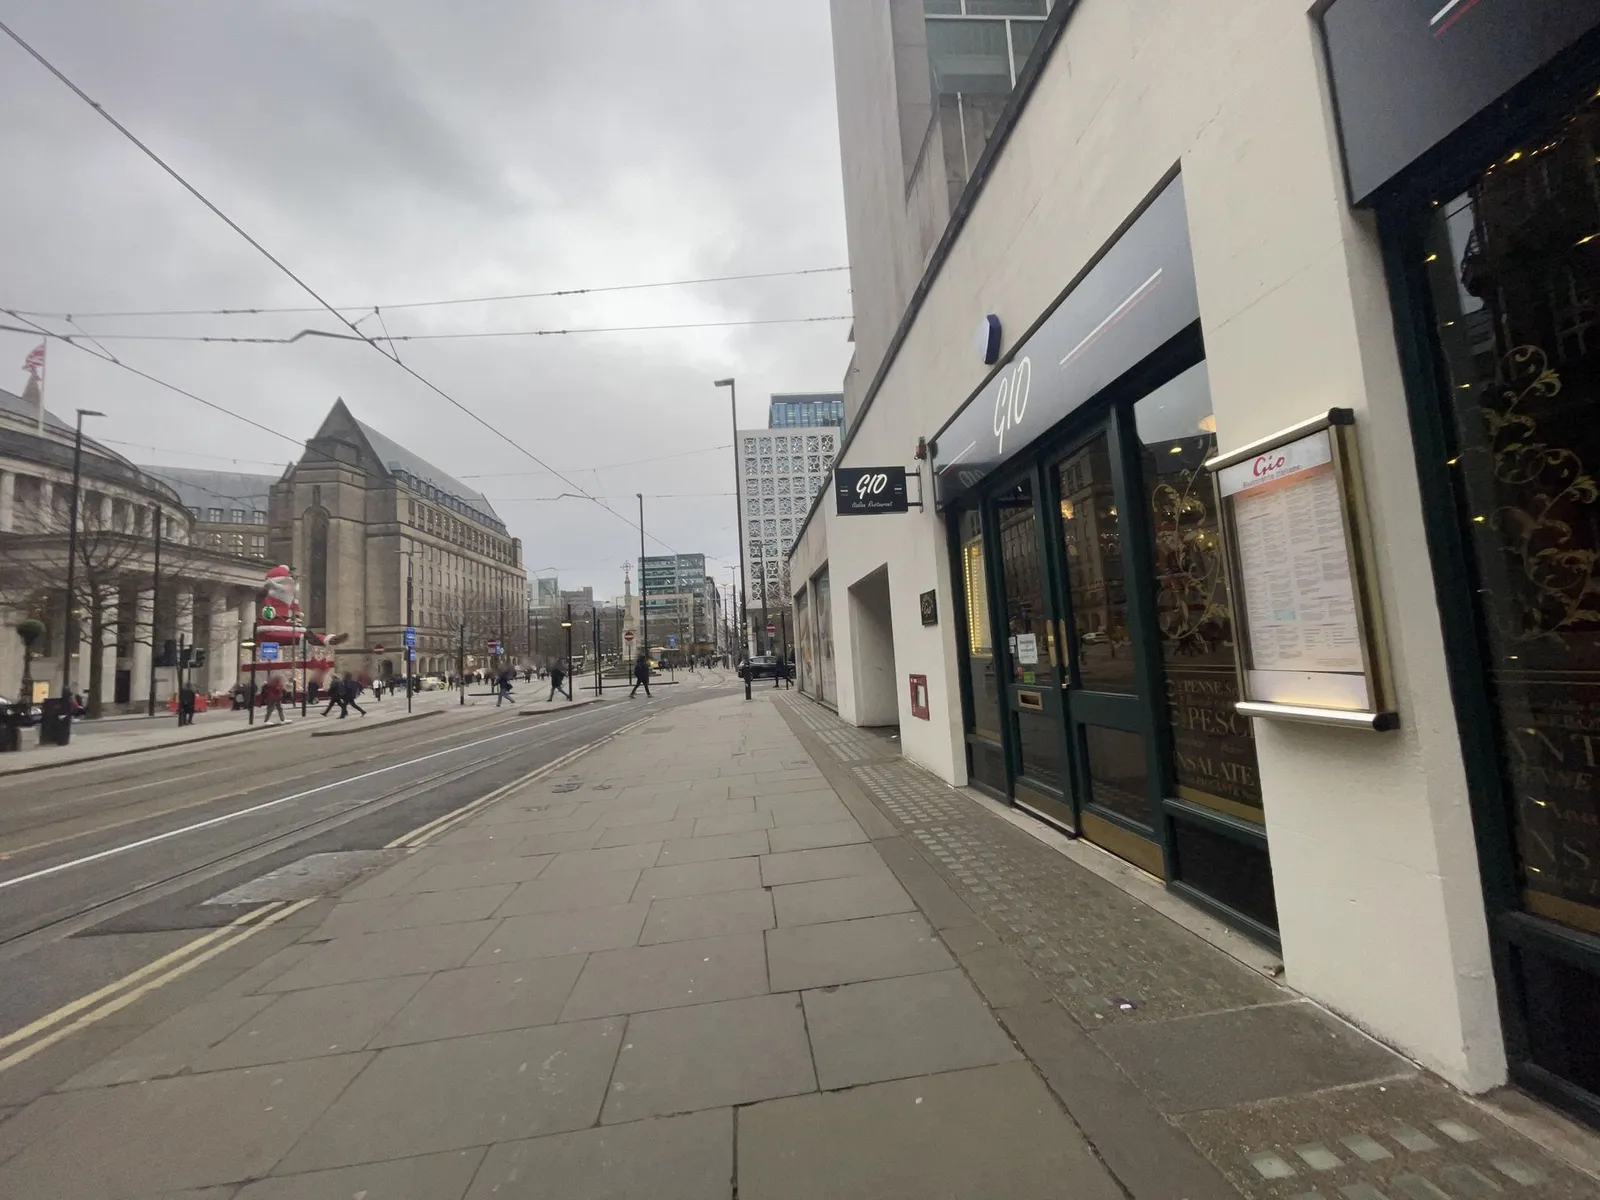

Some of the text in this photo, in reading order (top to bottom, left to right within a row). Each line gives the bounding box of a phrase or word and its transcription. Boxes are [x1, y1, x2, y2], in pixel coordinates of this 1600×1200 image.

[993, 355, 1031, 454] GIO
[1253, 455, 1285, 476] Gio
[856, 473, 888, 499] GIO
[867, 500, 893, 508] Restaurant
